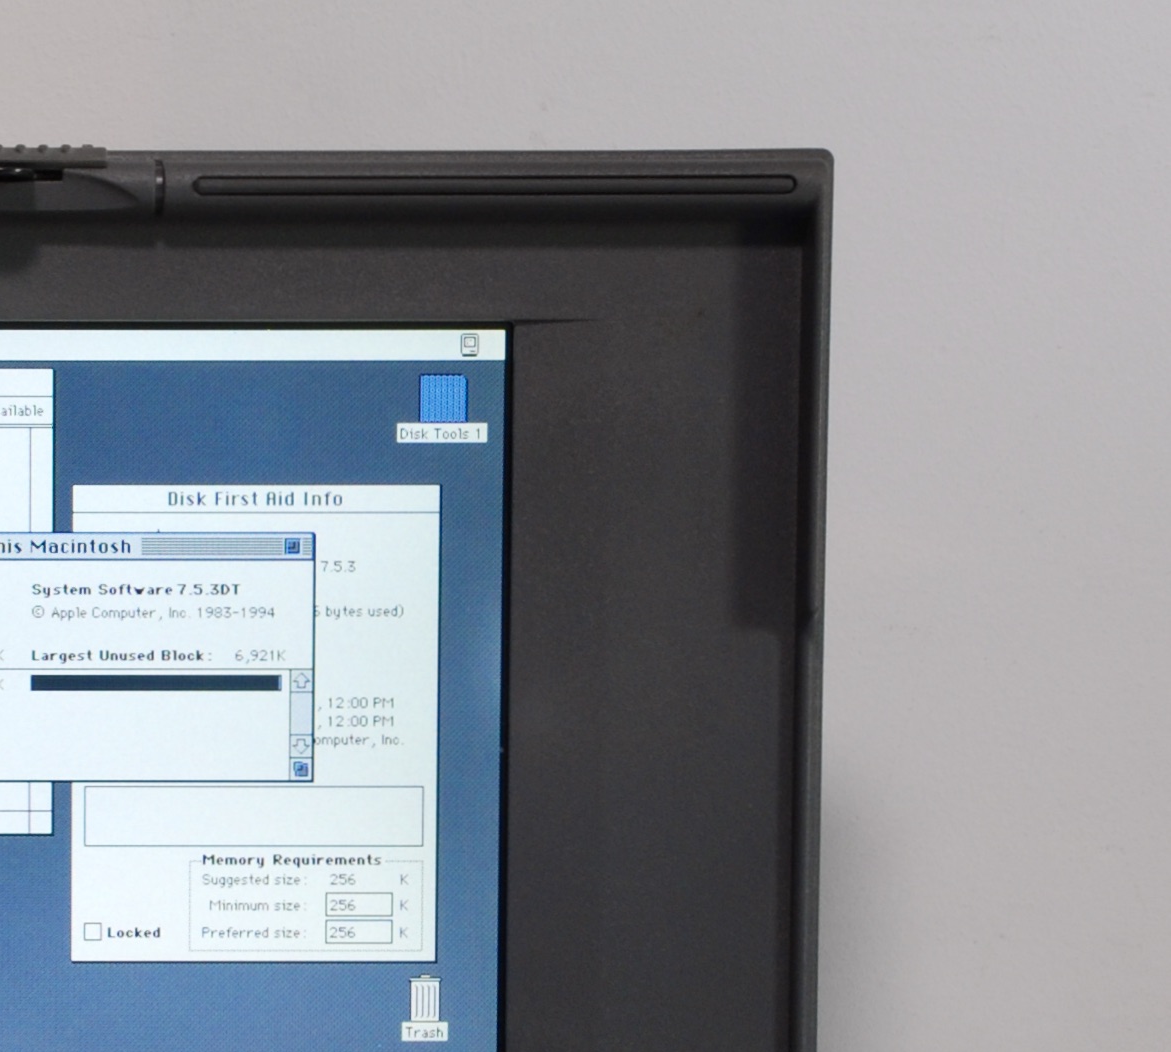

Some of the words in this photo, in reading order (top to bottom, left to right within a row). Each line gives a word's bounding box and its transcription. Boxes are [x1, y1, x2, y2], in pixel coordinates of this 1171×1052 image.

[400, 428, 427, 440] Disk
[434, 428, 469, 439] Tools
[476, 428, 480, 439] 1
[168, 492, 206, 506] Disk
[215, 492, 257, 506] First
[266, 492, 294, 506] Aid
[304, 492, 342, 506] Info
[31, 540, 130, 553] Macintosh
[321, 560, 356, 573] 7.5.3
[32, 584, 91, 598] System
[99, 584, 172, 595] Software
[178, 584, 240, 595] 7.5.3DT
[51, 607, 87, 621] Apple
[92, 607, 162, 621] Computer,
[169, 607, 190, 618] Inc.
[198, 606, 275, 619] 1983-1994
[326, 606, 362, 620] bytes
[368, 604, 404, 618] used)
[32, 650, 92, 664] Largest
[100, 650, 154, 661] Unused
[161, 650, 211, 661] Block:
[235, 649, 285, 664] 6,921K
[329, 697, 368, 709] 12:00
[373, 697, 394, 708] PM
[329, 715, 368, 727] 12:00
[373, 715, 394, 727] PM
[382, 734, 404, 745] Inc.
[203, 855, 264, 868] Memory
[273, 854, 381, 868] Requirements
[202, 874, 269, 888] Suggested
[275, 874, 306, 885] size:
[330, 873, 356, 885] 256
[400, 874, 408, 885] K
[209, 900, 269, 911] Minimum
[274, 900, 306, 911] size:
[330, 899, 356, 911] 256
[400, 900, 408, 911] K
[108, 927, 160, 938] Locked
[202, 927, 269, 938] Preferred
[274, 927, 306, 939] size:
[330, 926, 356, 938] 256
[399, 927, 408, 938] K
[405, 1026, 443, 1039] Trash
